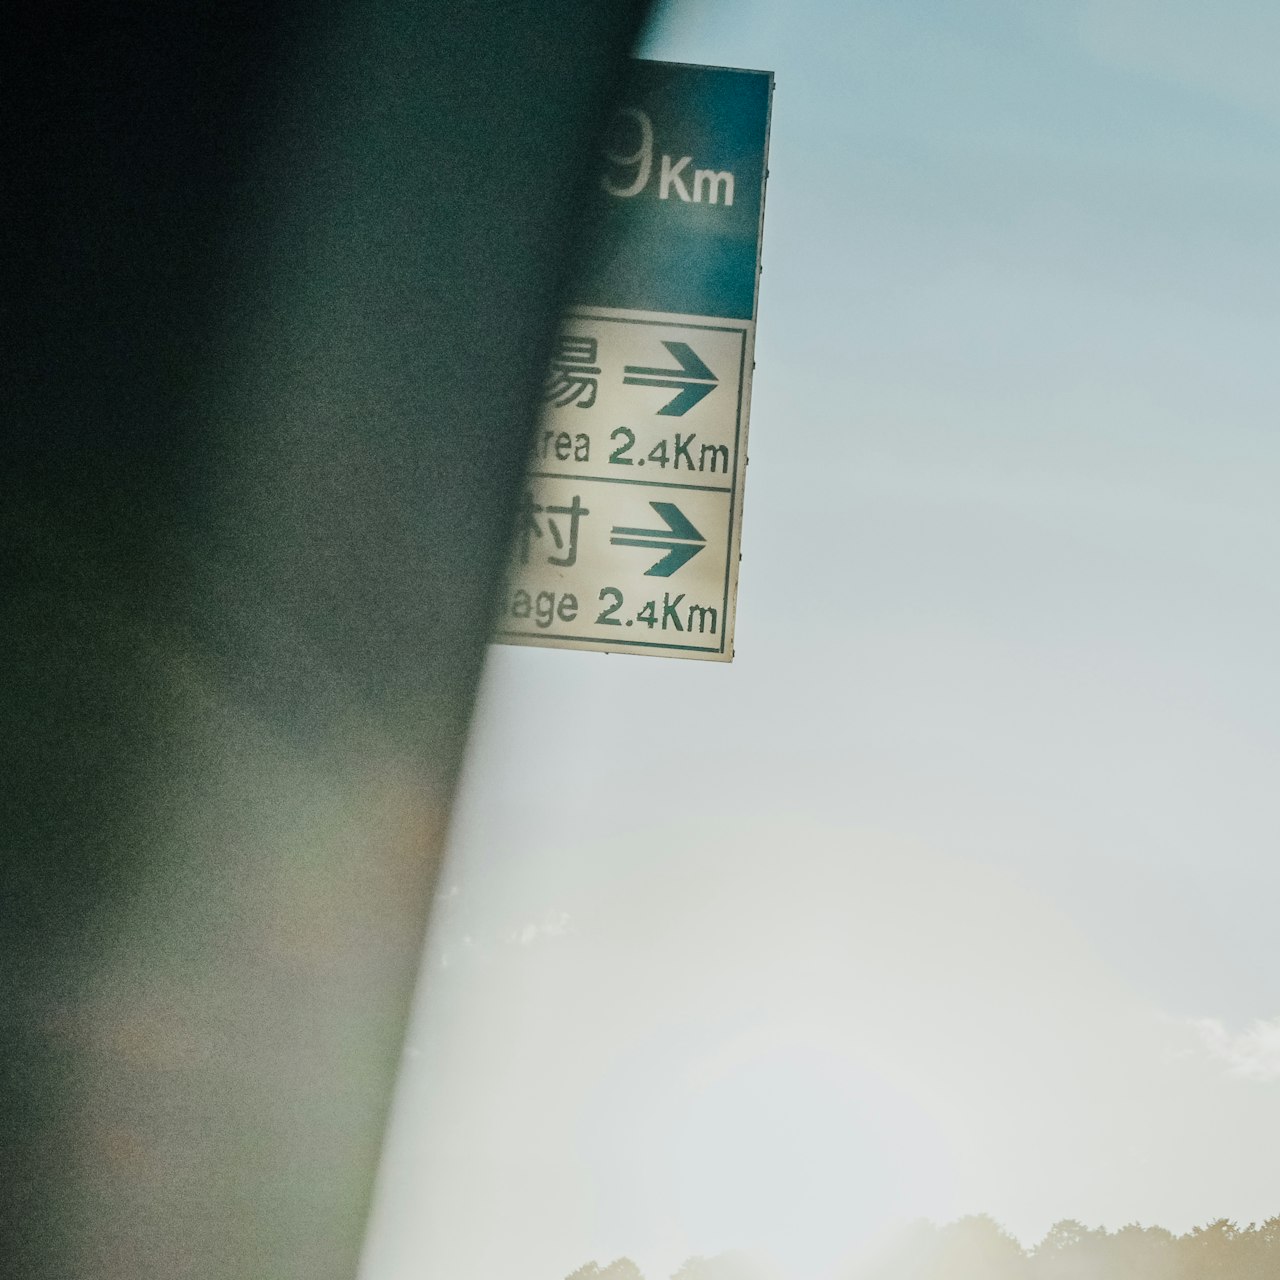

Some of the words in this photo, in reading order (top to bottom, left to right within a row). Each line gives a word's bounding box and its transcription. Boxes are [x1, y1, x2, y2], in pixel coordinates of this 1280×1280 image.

[537, 429, 590, 462] rea
[608, 426, 730, 473] 2.4Km
[509, 588, 579, 628] age
[594, 586, 719, 635] 2.4Km
